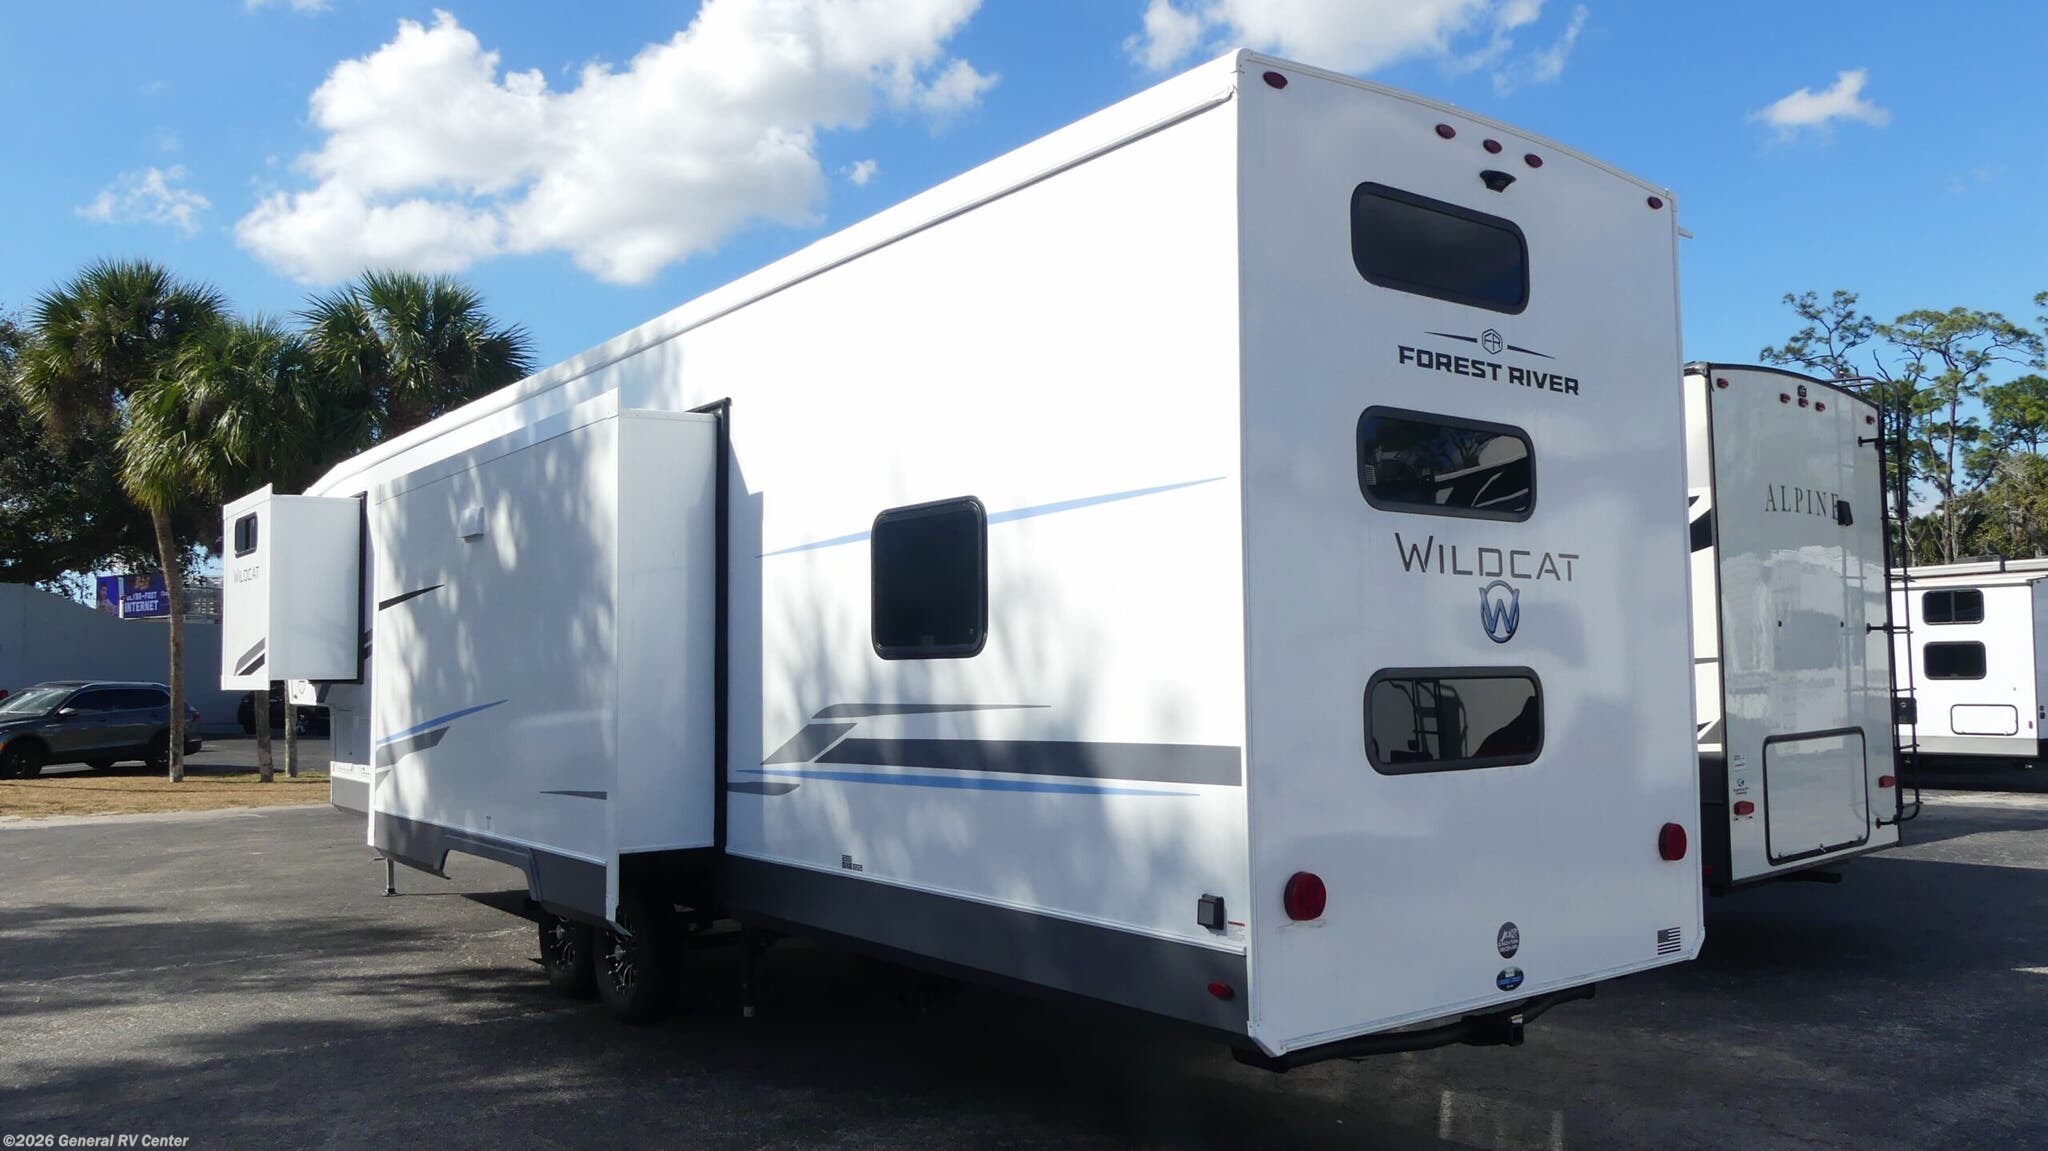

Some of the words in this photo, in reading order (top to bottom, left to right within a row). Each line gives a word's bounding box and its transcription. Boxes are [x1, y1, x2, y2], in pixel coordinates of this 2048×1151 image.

[1398, 345, 1502, 381] FOREST
[1507, 366, 1580, 396] RIVER
[124, 600, 159, 613] INTERNET
